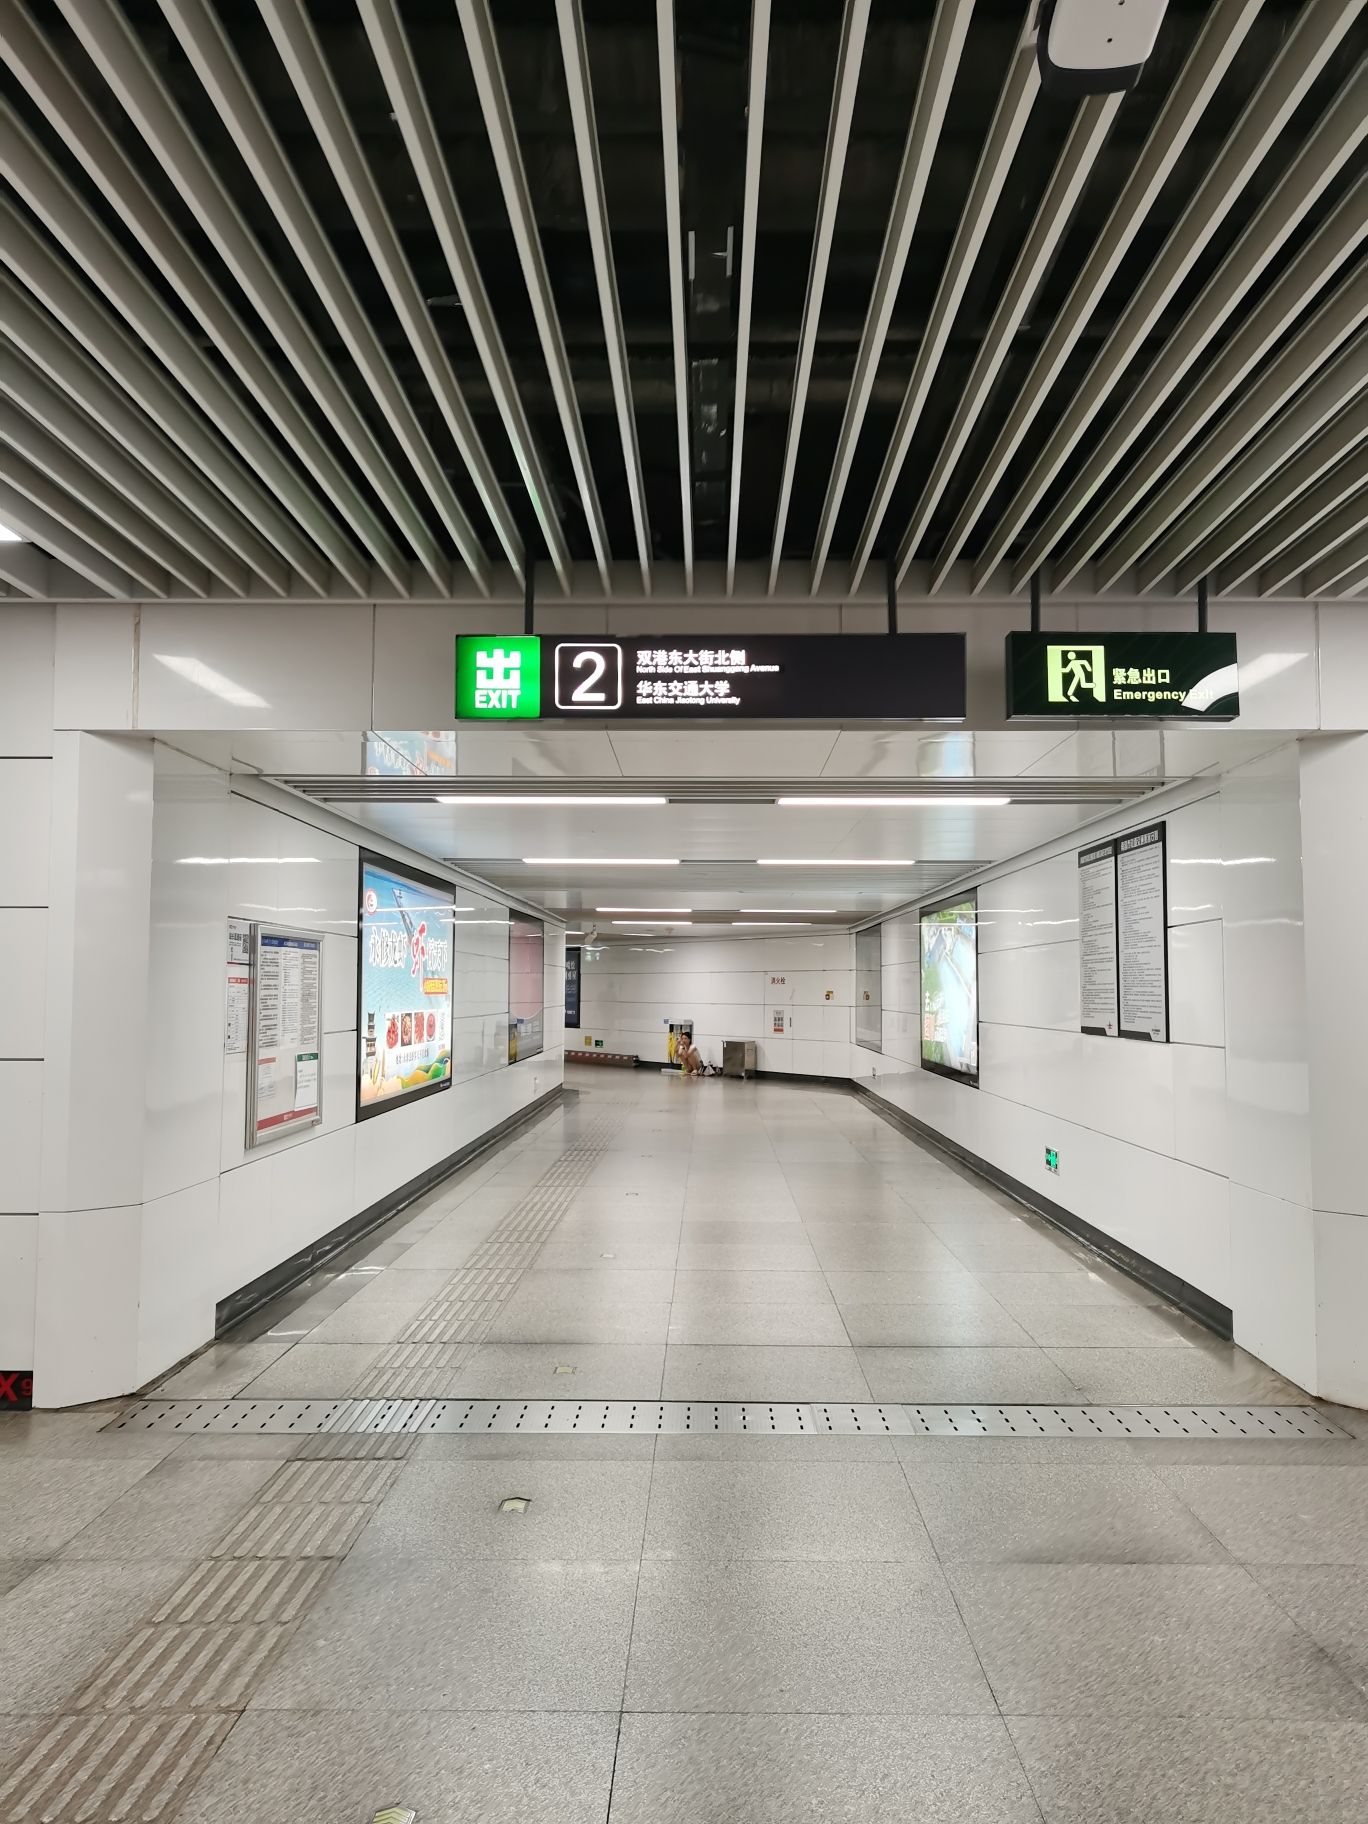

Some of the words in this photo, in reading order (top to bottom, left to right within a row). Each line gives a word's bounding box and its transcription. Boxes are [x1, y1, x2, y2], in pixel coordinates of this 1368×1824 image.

[636, 649, 746, 666] 双港东大街北侧
[571, 650, 606, 702] 2
[636, 665, 656, 673] North
[657, 665, 673, 673] Side
[684, 665, 701, 673] East
[750, 664, 780, 672] Avenue
[1112, 667, 1170, 685] 紧急出口
[636, 680, 730, 697] 华东交通大学
[1113, 688, 1186, 702] Emergency
[475, 689, 521, 709] EXIT
[636, 696, 653, 704] East
[654, 696, 675, 704] China
[675, 696, 705, 705] Jiaotong
[706, 696, 741, 705] University
